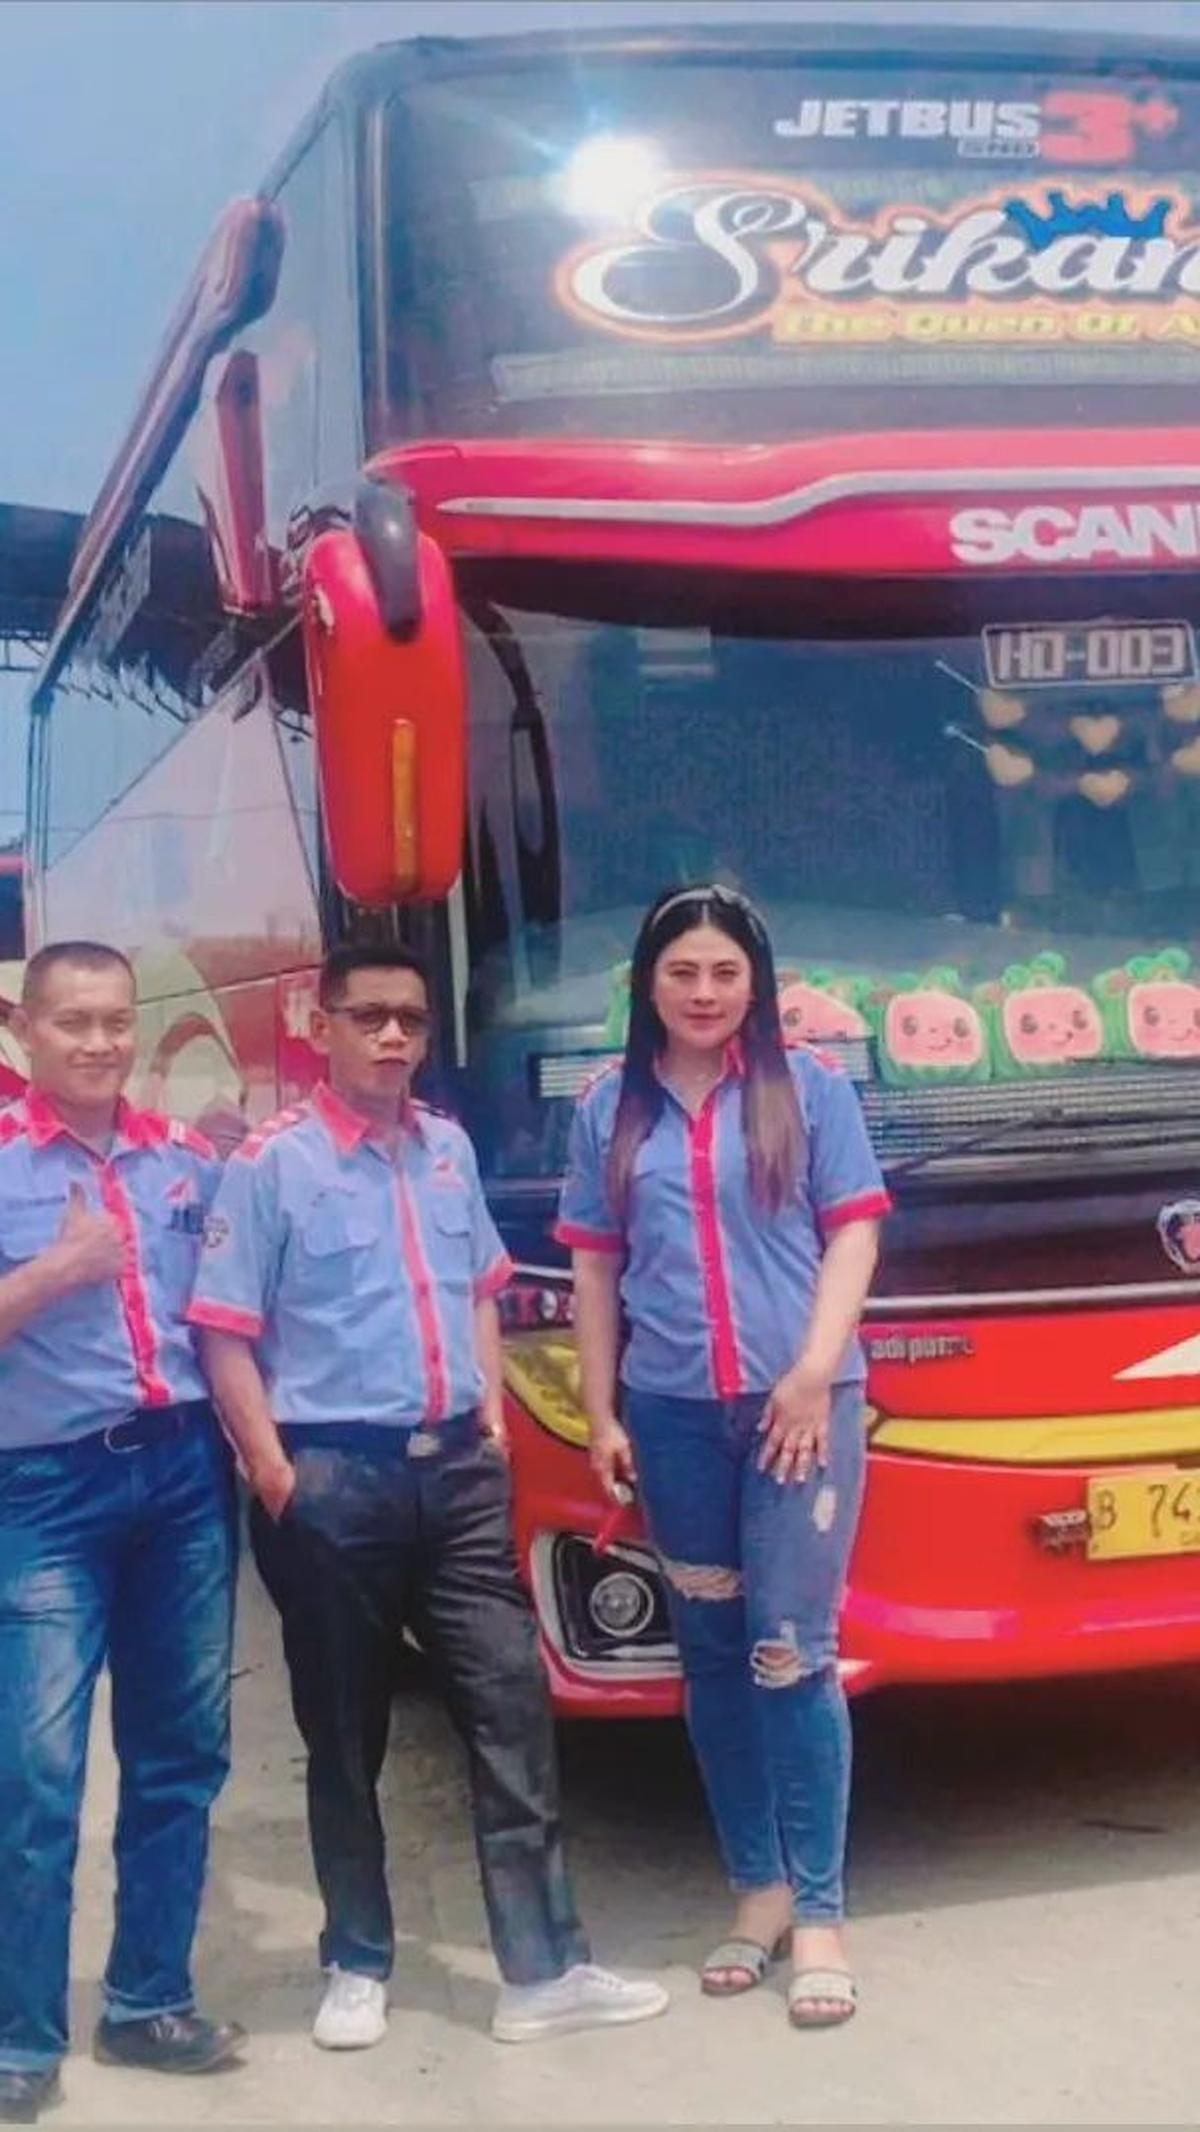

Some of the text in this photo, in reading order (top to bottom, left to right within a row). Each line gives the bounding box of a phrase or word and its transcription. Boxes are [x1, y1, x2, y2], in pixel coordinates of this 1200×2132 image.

[774, 99, 1040, 138] JETBUS
[950, 504, 1200, 564] SCAN
[1147, 1480, 1200, 1539] 74
